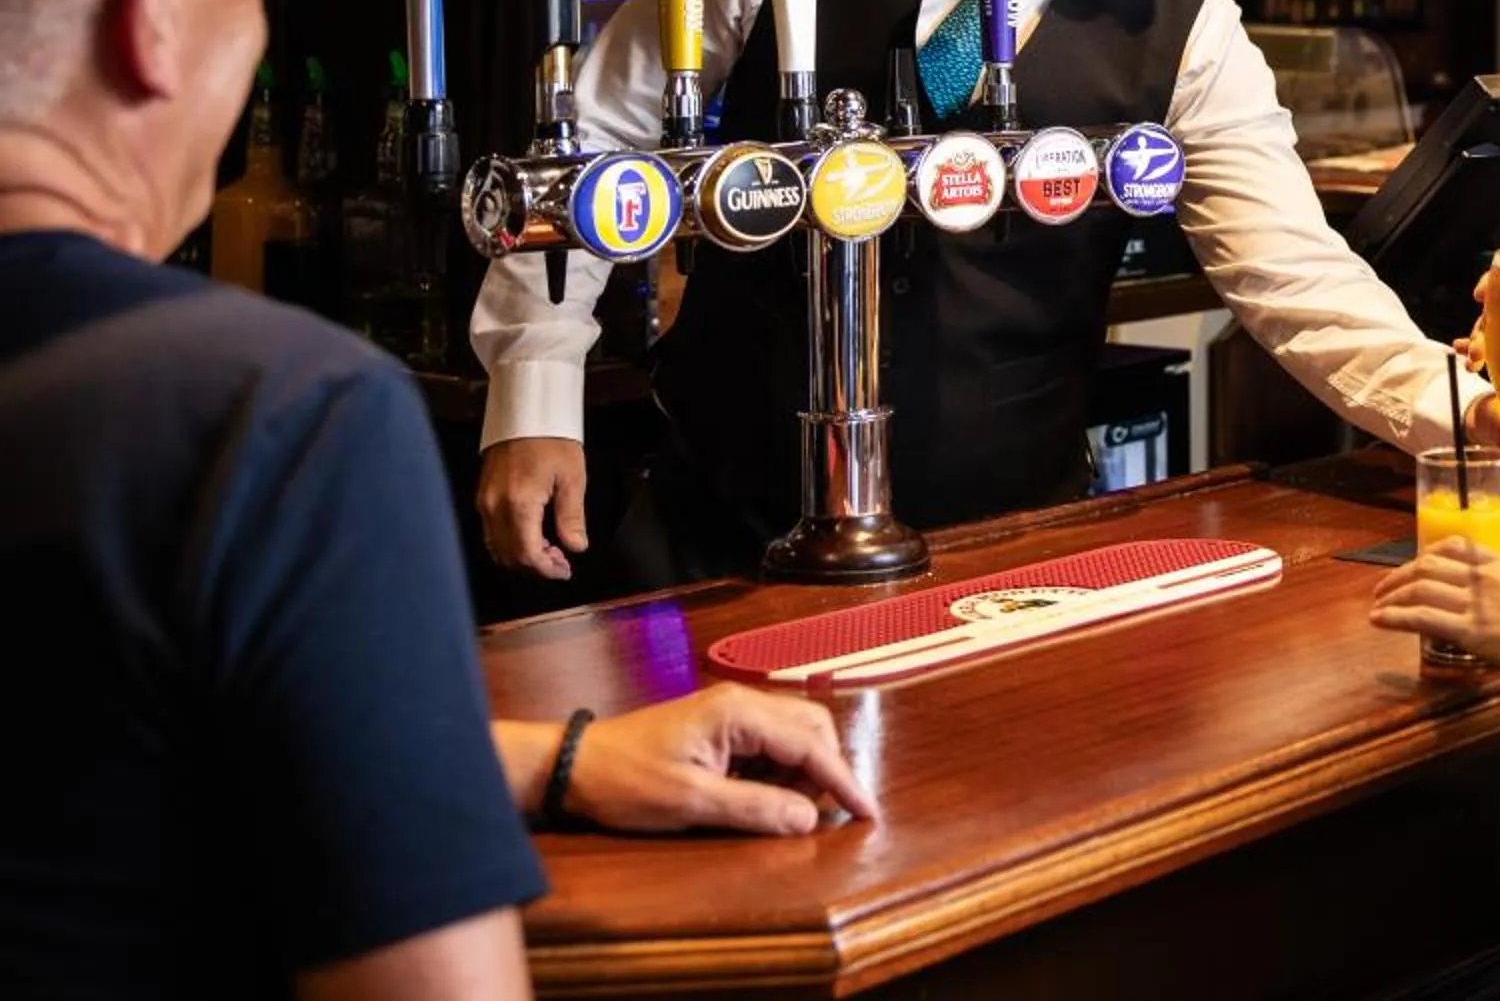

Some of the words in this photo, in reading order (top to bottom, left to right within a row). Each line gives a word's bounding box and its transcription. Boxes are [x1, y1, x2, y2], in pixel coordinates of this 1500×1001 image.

[942, 171, 982, 186] STELLA
[943, 185, 984, 200] ARTOIS
[1043, 179, 1081, 198] BEST
[615, 182, 647, 232] F
[727, 185, 801, 212] GUINNESS
